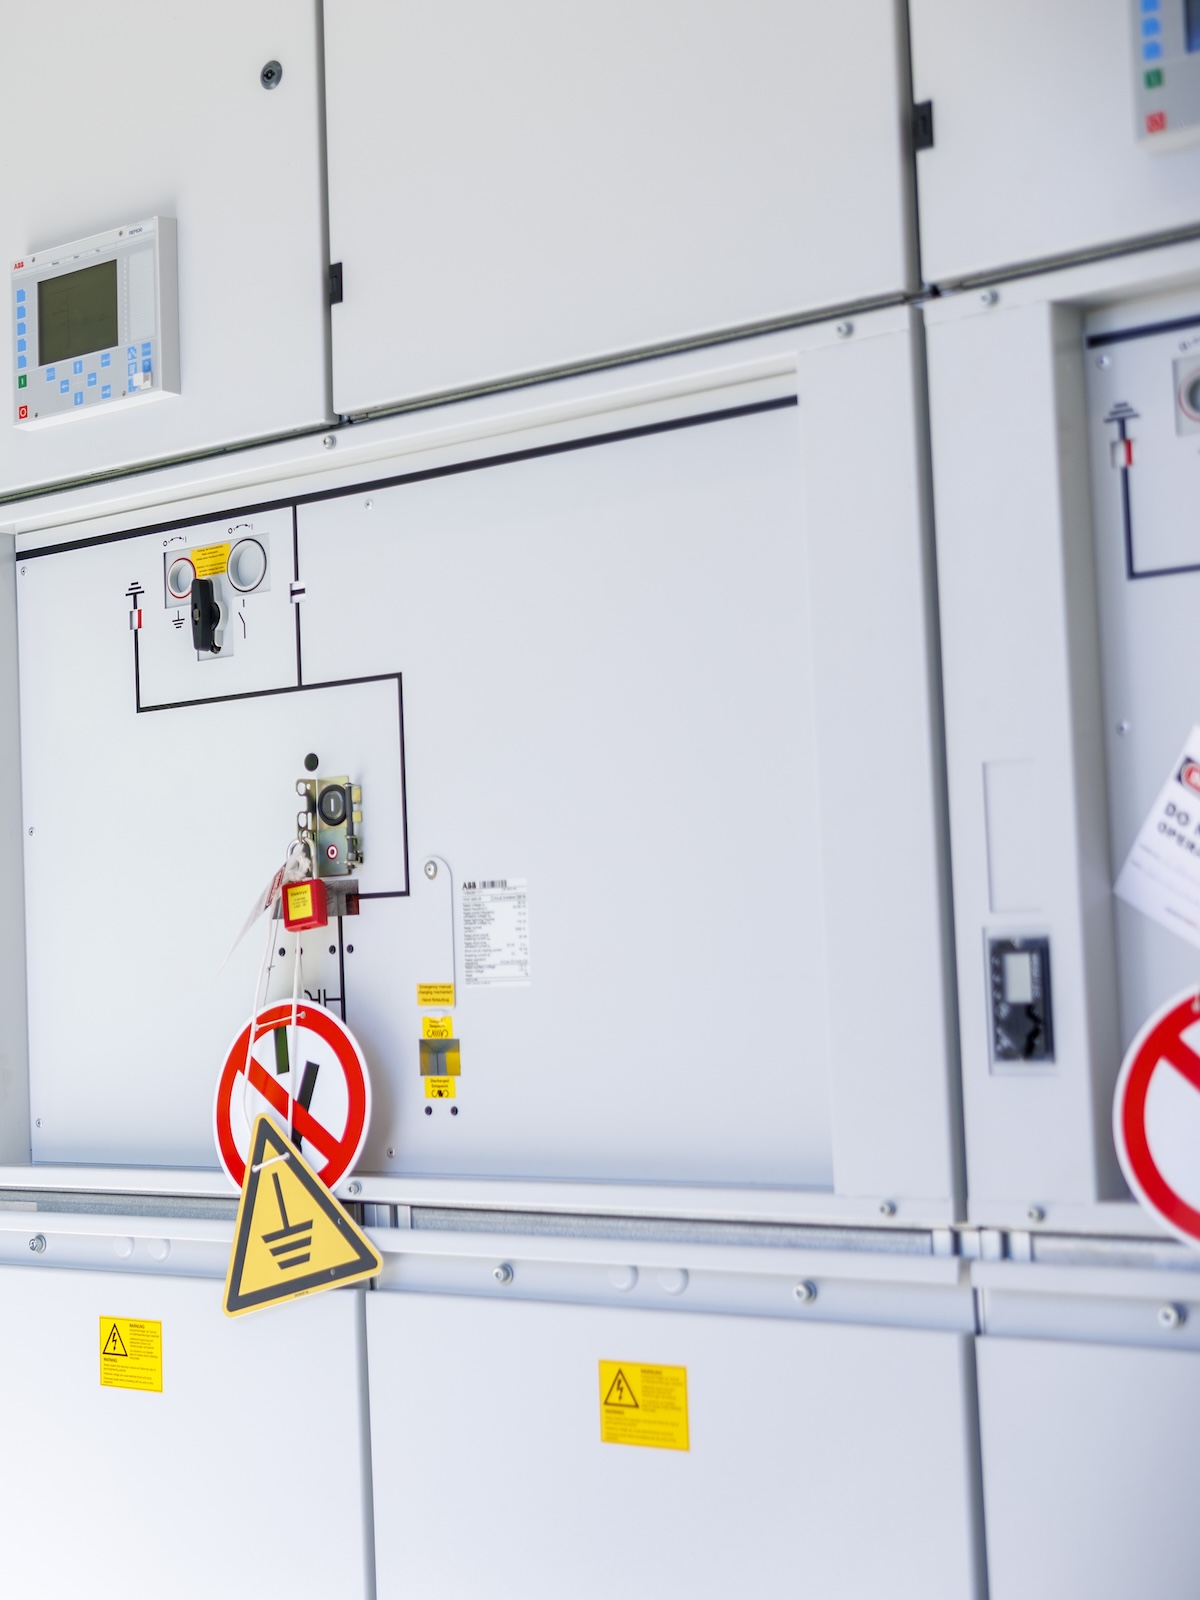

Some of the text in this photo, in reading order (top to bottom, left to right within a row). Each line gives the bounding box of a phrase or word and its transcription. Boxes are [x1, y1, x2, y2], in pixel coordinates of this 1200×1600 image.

[13, 261, 25, 270] ABB
[1164, 800, 1191, 827] DO
[461, 881, 477, 890] ABB
